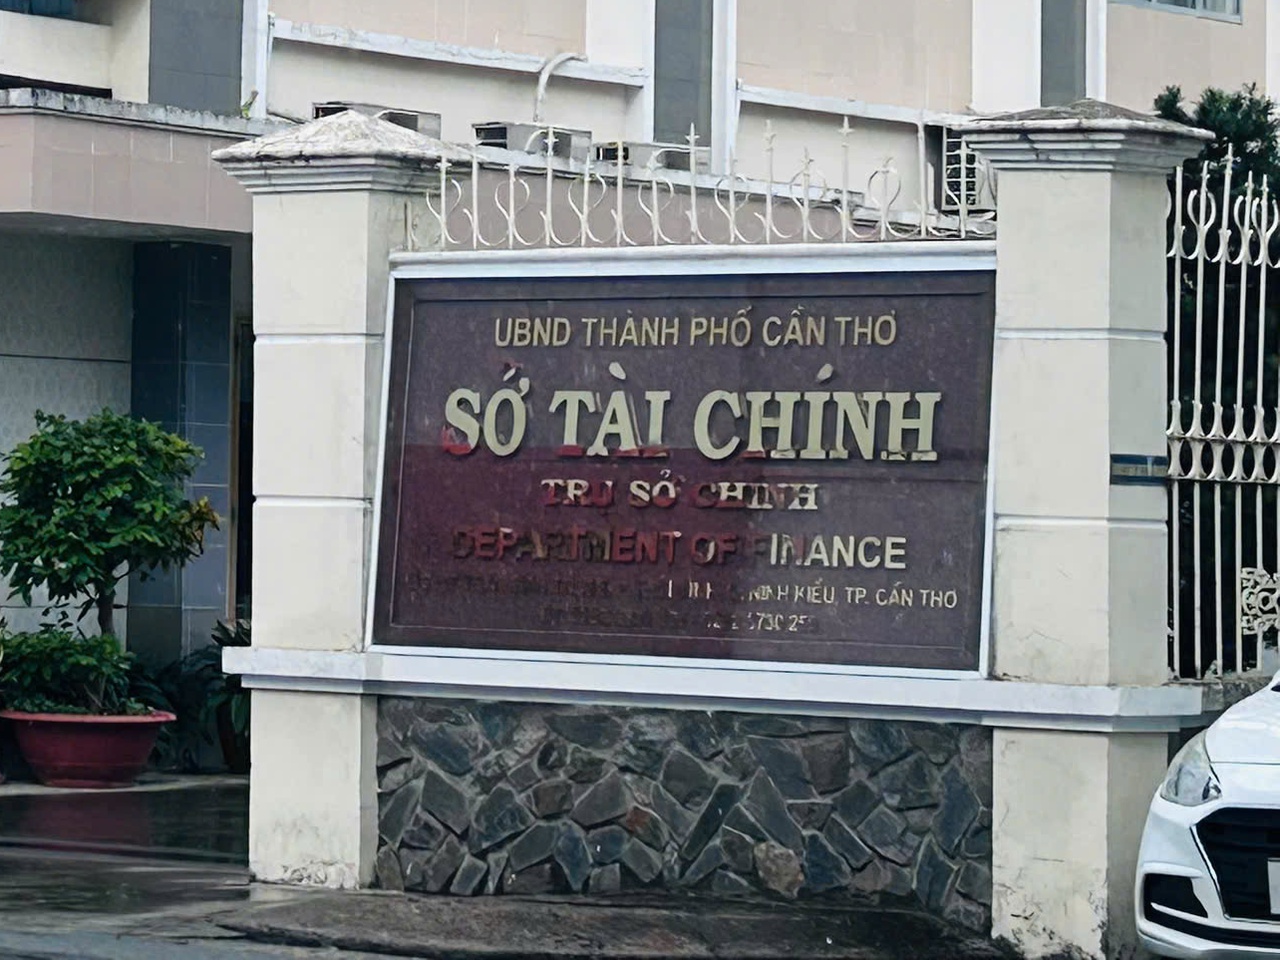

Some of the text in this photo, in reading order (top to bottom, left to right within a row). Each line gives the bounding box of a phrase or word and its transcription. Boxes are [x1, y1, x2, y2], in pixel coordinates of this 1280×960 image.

[494, 303, 898, 348] UBND THÀNH PHỐ CẦN THƠ
[548, 361, 671, 458] TÀI
[693, 363, 942, 462] CHÍNH
